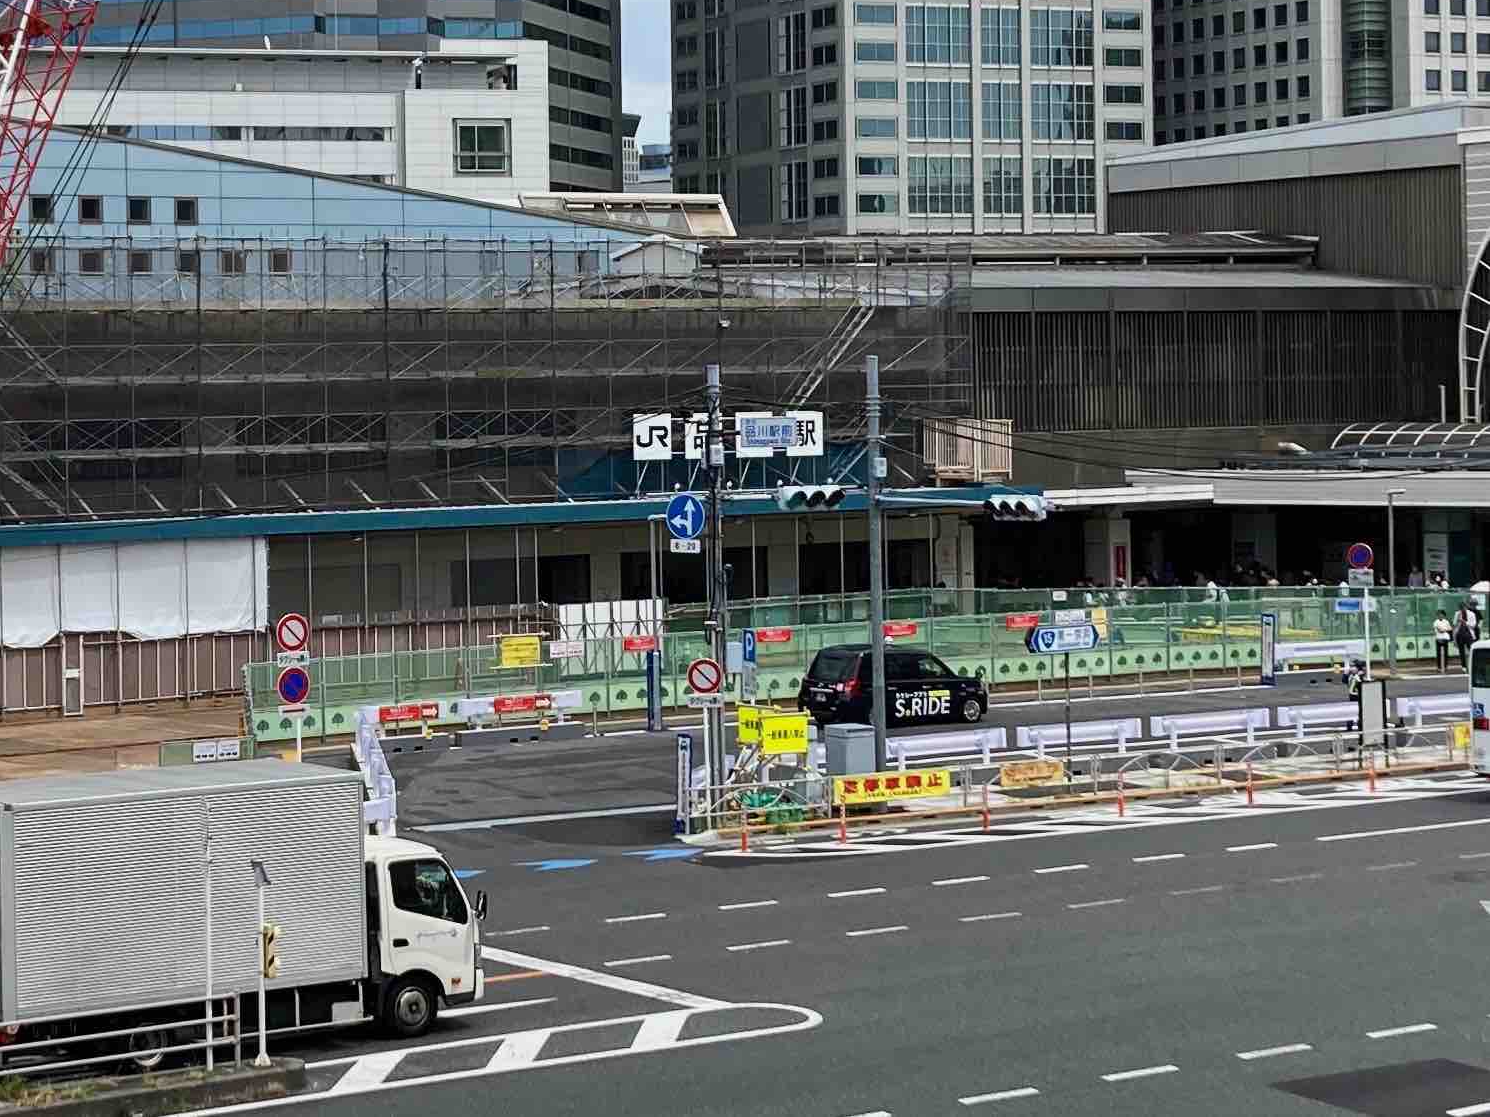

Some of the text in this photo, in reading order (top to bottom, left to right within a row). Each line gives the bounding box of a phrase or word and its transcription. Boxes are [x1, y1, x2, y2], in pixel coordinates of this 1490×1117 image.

[636, 425, 668, 447] JR
[745, 633, 754, 660] P
[895, 696, 951, 718] S.RIDE
